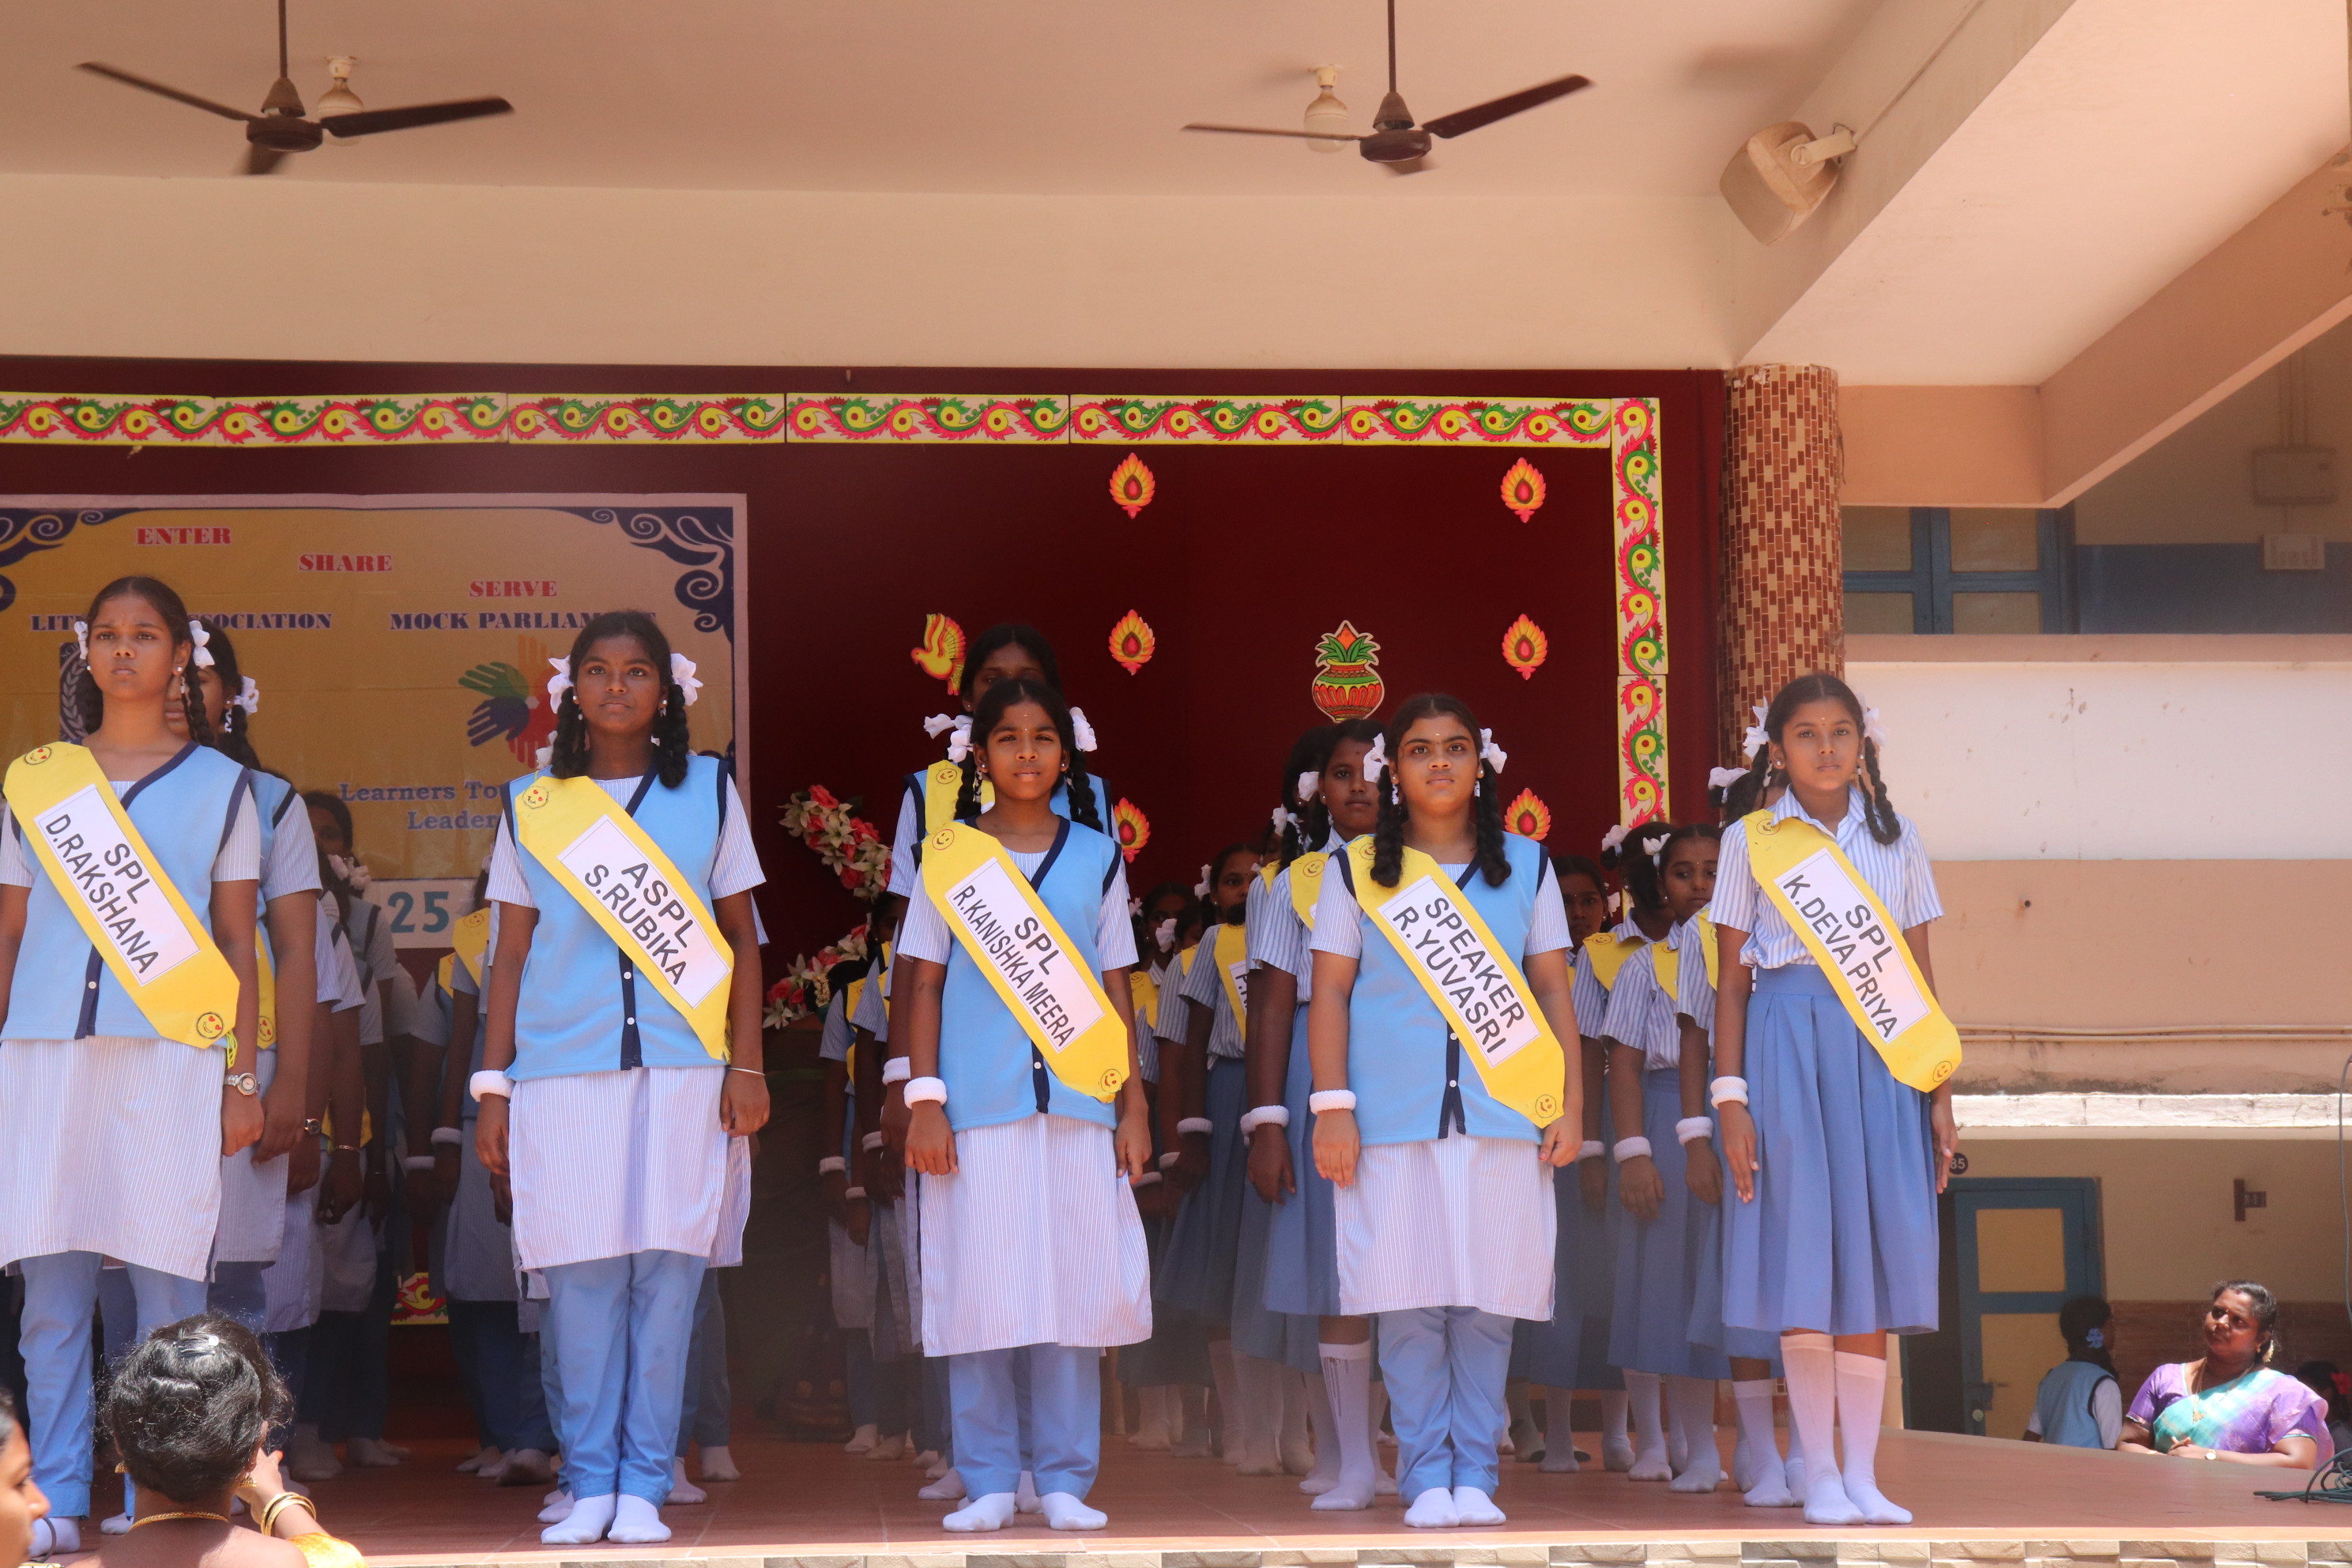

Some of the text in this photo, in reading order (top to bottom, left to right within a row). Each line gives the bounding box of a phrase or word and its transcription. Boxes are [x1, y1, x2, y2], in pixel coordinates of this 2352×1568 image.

[137, 528, 231, 545] ENTER
[299, 555, 391, 571] SHARE
[390, 613, 469, 630] MOCK
[469, 581, 557, 597] SERVE
[340, 784, 456, 801] Learners
[46, 814, 159, 974] D.RAKSHANA
[104, 843, 150, 904] SPL
[621, 862, 693, 948] ASPL
[388, 891, 450, 933] 25
[585, 865, 686, 985] S.RUBIKA
[1845, 904, 1892, 973] SPL
[953, 884, 1075, 1046] R.KANISHKA MEERA
[1015, 917, 1059, 975] SPL
[1426, 897, 1525, 1028] SPEAKER
[1783, 874, 1898, 1038] K.DEVA PRIYA
[1393, 906, 1506, 1053] R.YUVASRI
